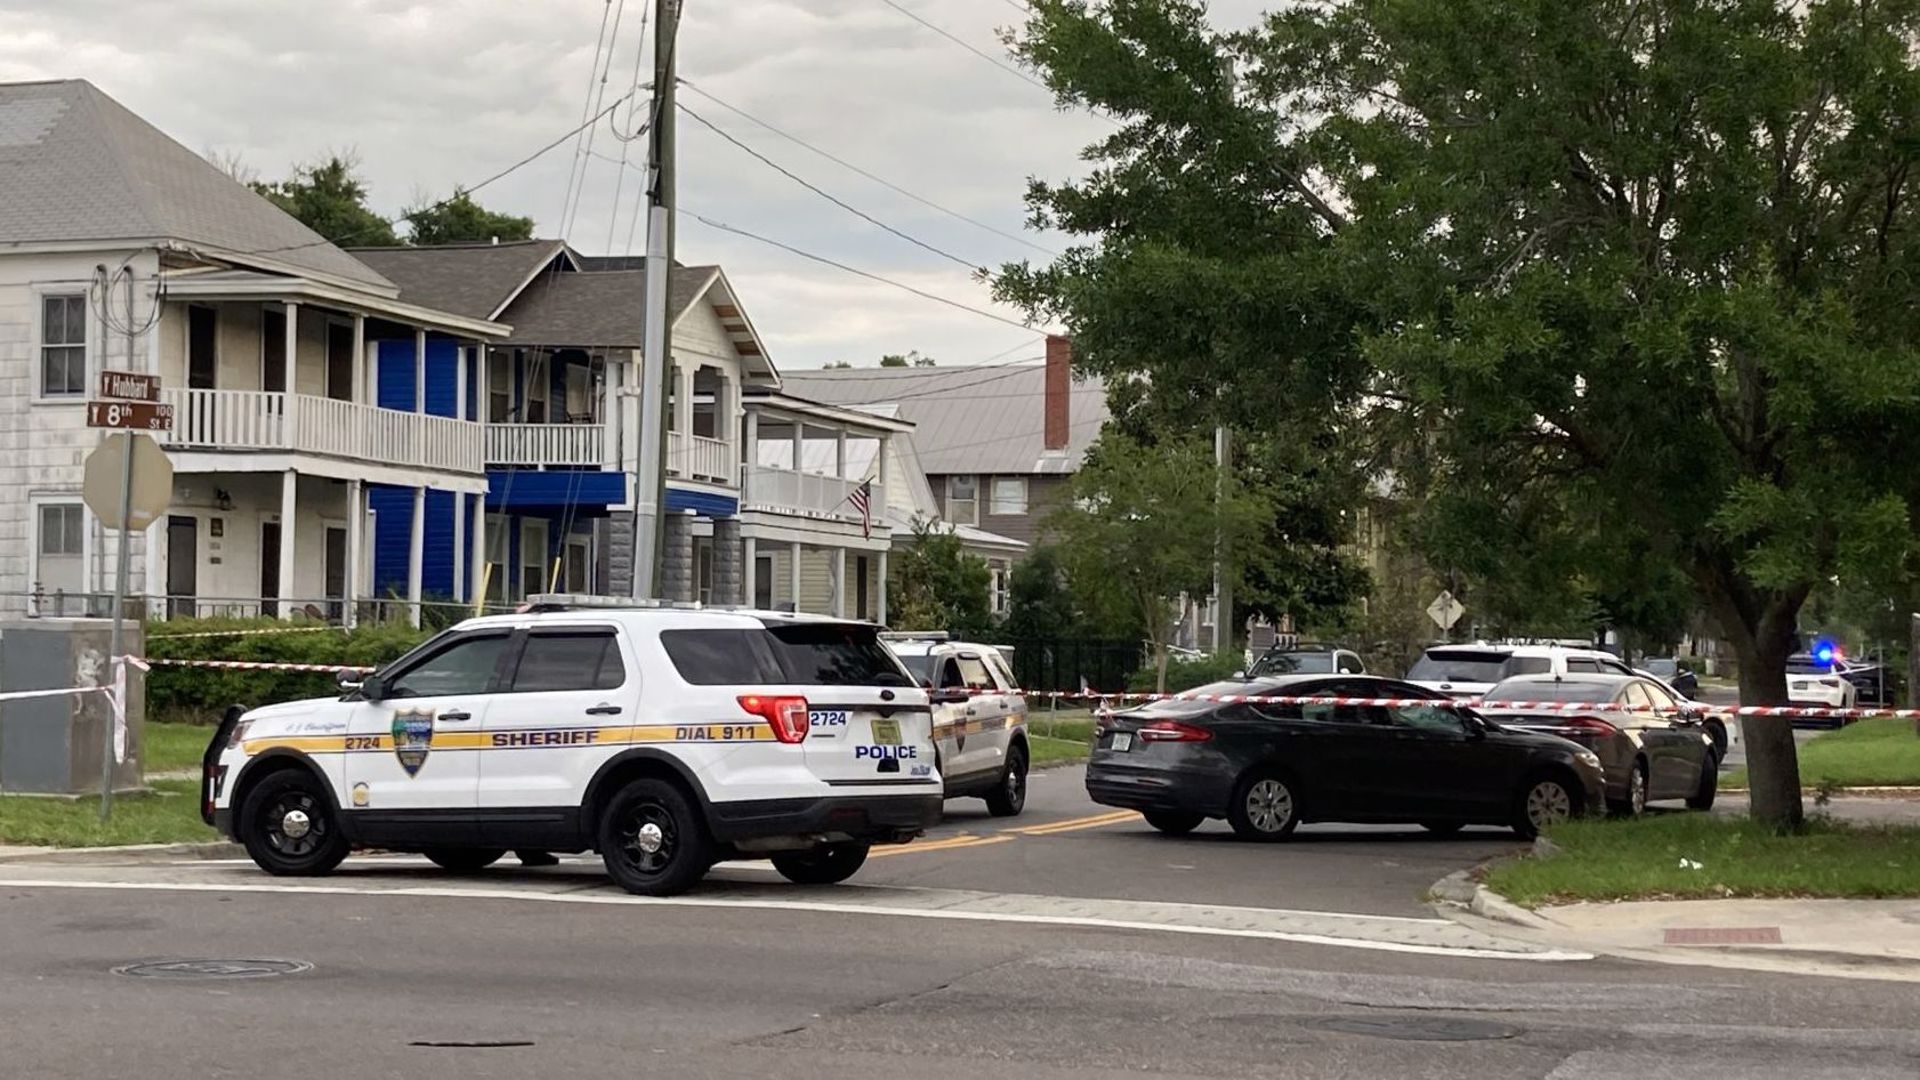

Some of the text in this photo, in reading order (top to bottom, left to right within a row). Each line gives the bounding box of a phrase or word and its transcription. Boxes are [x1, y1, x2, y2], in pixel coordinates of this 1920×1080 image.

[112, 375, 148, 399] Hubbard
[108, 404, 133, 426] 8th
[155, 406, 173, 416] 100
[149, 419, 172, 430] St E
[811, 712, 846, 726] 2724
[493, 731, 598, 746] SHERIFF
[675, 725, 756, 741] DIAL 911
[345, 737, 379, 749] 2724
[855, 745, 917, 759] POLICE
